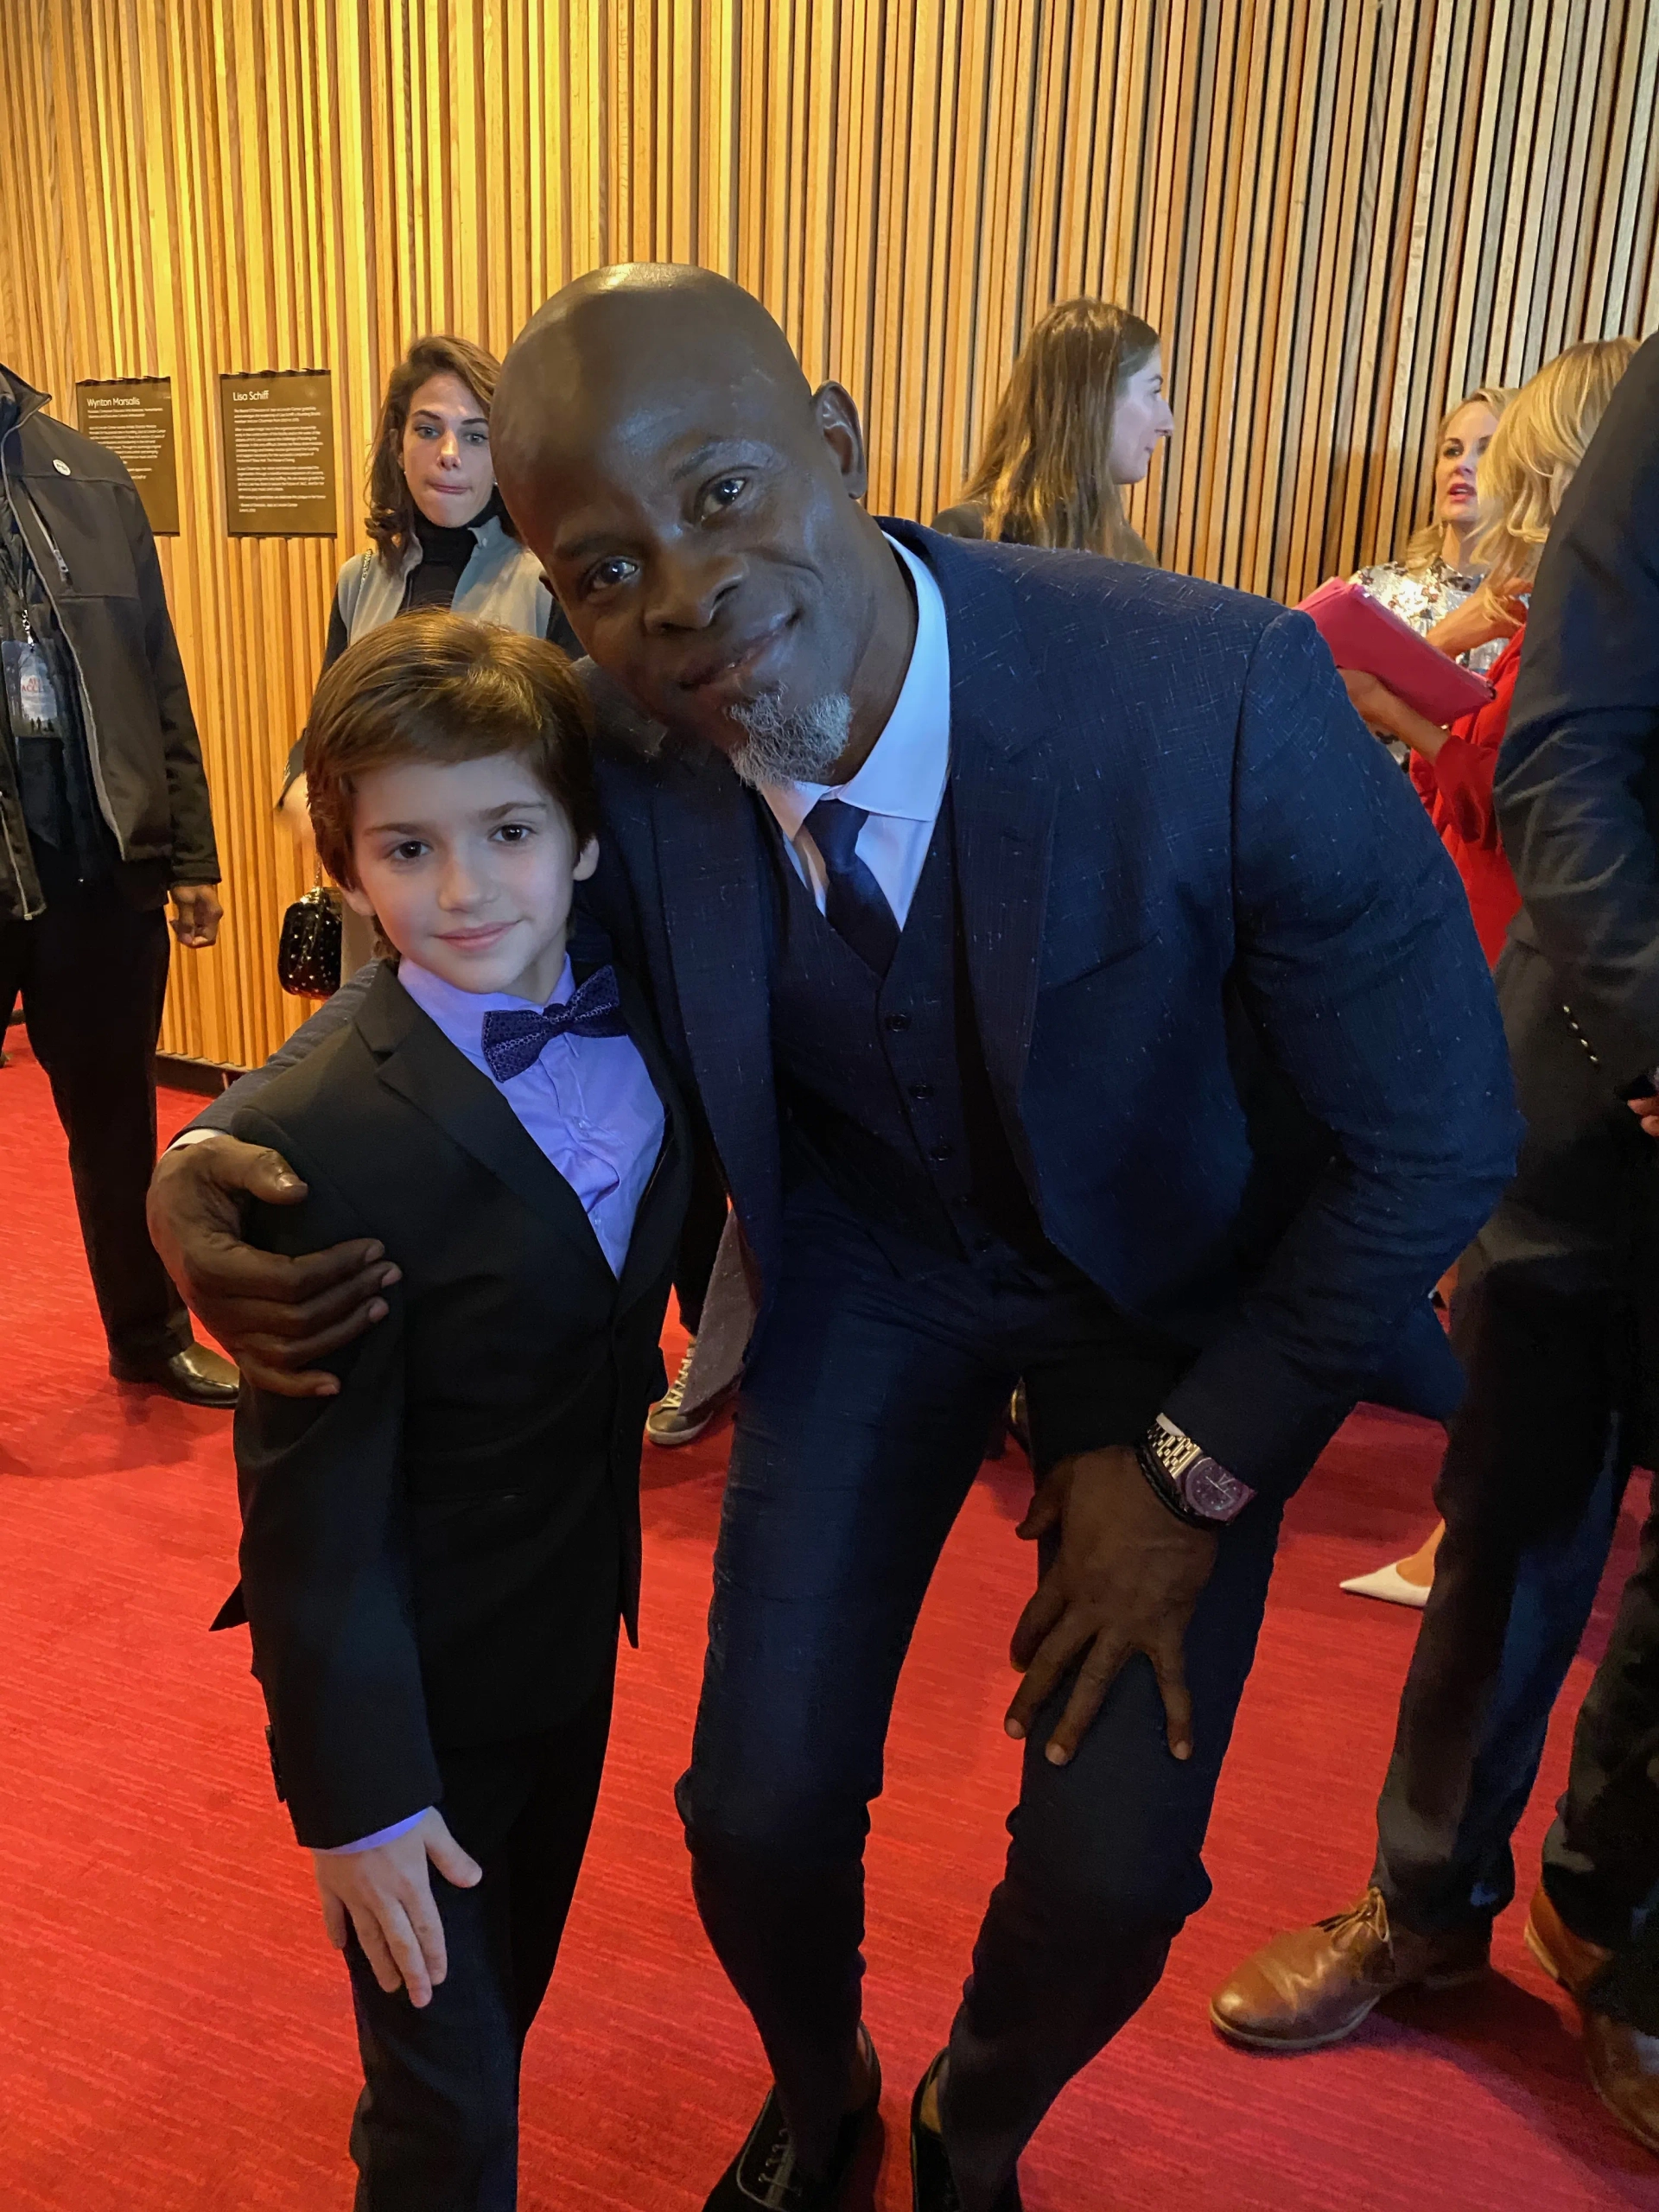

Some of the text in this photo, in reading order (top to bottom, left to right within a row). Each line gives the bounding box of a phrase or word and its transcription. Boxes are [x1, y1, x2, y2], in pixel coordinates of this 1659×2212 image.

[232, 390, 270, 401] Lisa Schiff
[86, 397, 141, 409] Wynton Marsalis
